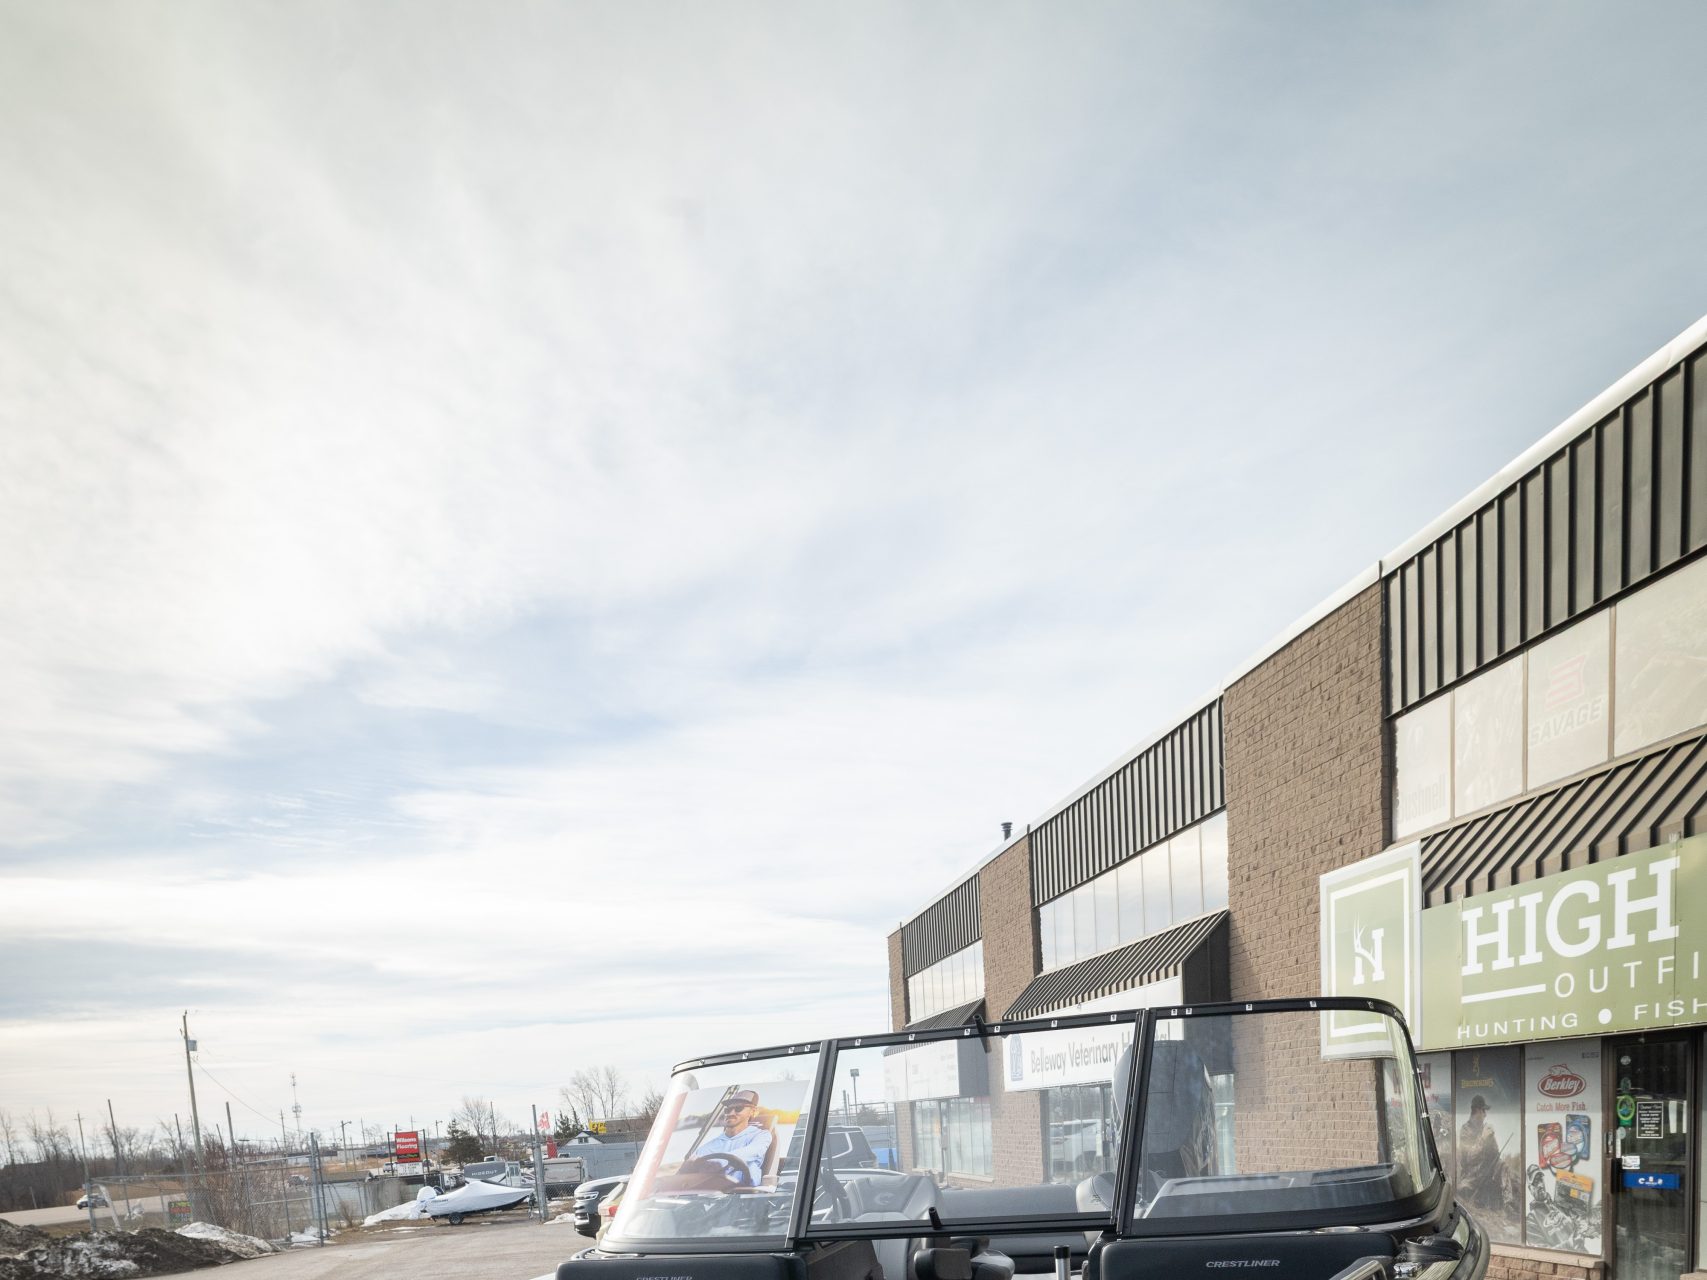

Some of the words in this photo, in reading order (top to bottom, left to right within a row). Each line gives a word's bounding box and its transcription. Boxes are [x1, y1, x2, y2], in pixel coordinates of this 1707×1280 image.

[1530, 698, 1603, 747] SAVAGE
[1461, 855, 1681, 977] HIGH
[1554, 951, 1700, 998] OUTFI
[1457, 1012, 1578, 1040] HUNTING
[1068, 1037, 1119, 1066] Veterinary
[1544, 1077, 1581, 1094] Berkley
[1205, 1259, 1281, 1269] CRESTLINER
